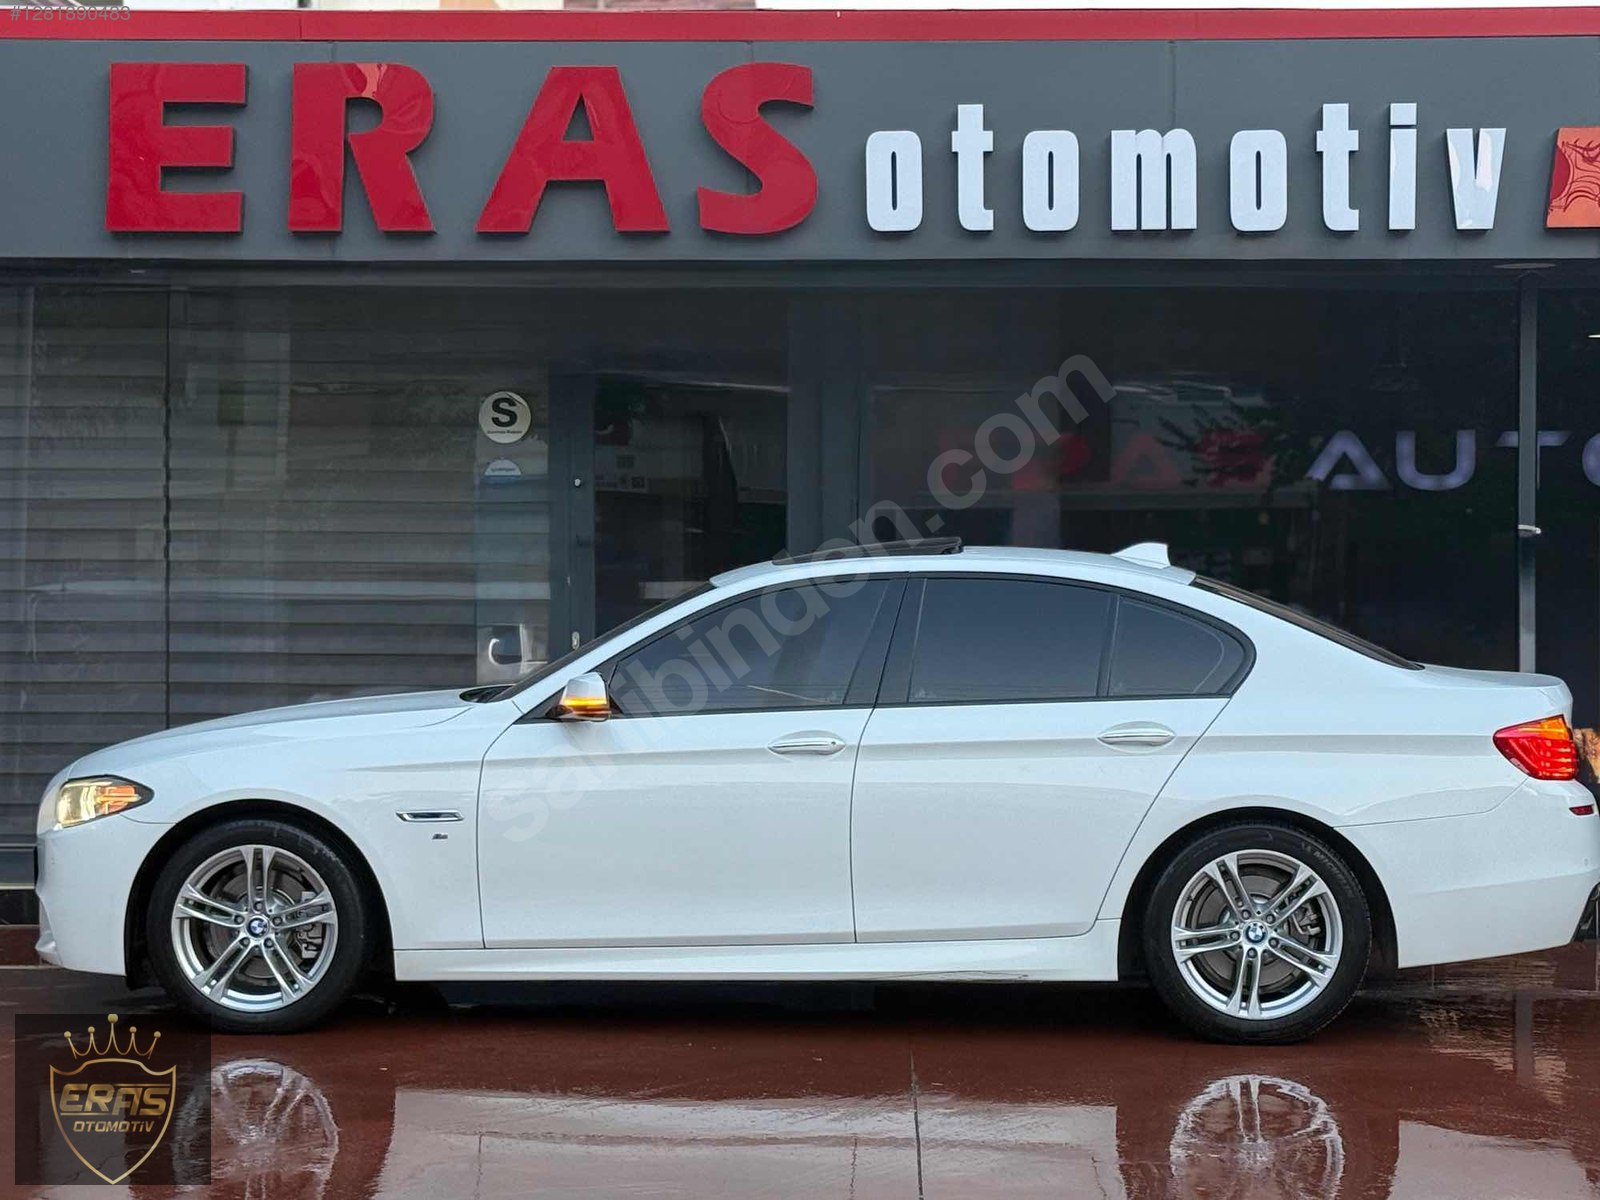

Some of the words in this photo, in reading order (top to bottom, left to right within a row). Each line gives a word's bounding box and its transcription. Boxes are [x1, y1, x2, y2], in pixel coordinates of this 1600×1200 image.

[106, 62, 818, 235] ERAS
[865, 102, 1506, 232] otomotiv
[1305, 429, 1600, 491] AUT
